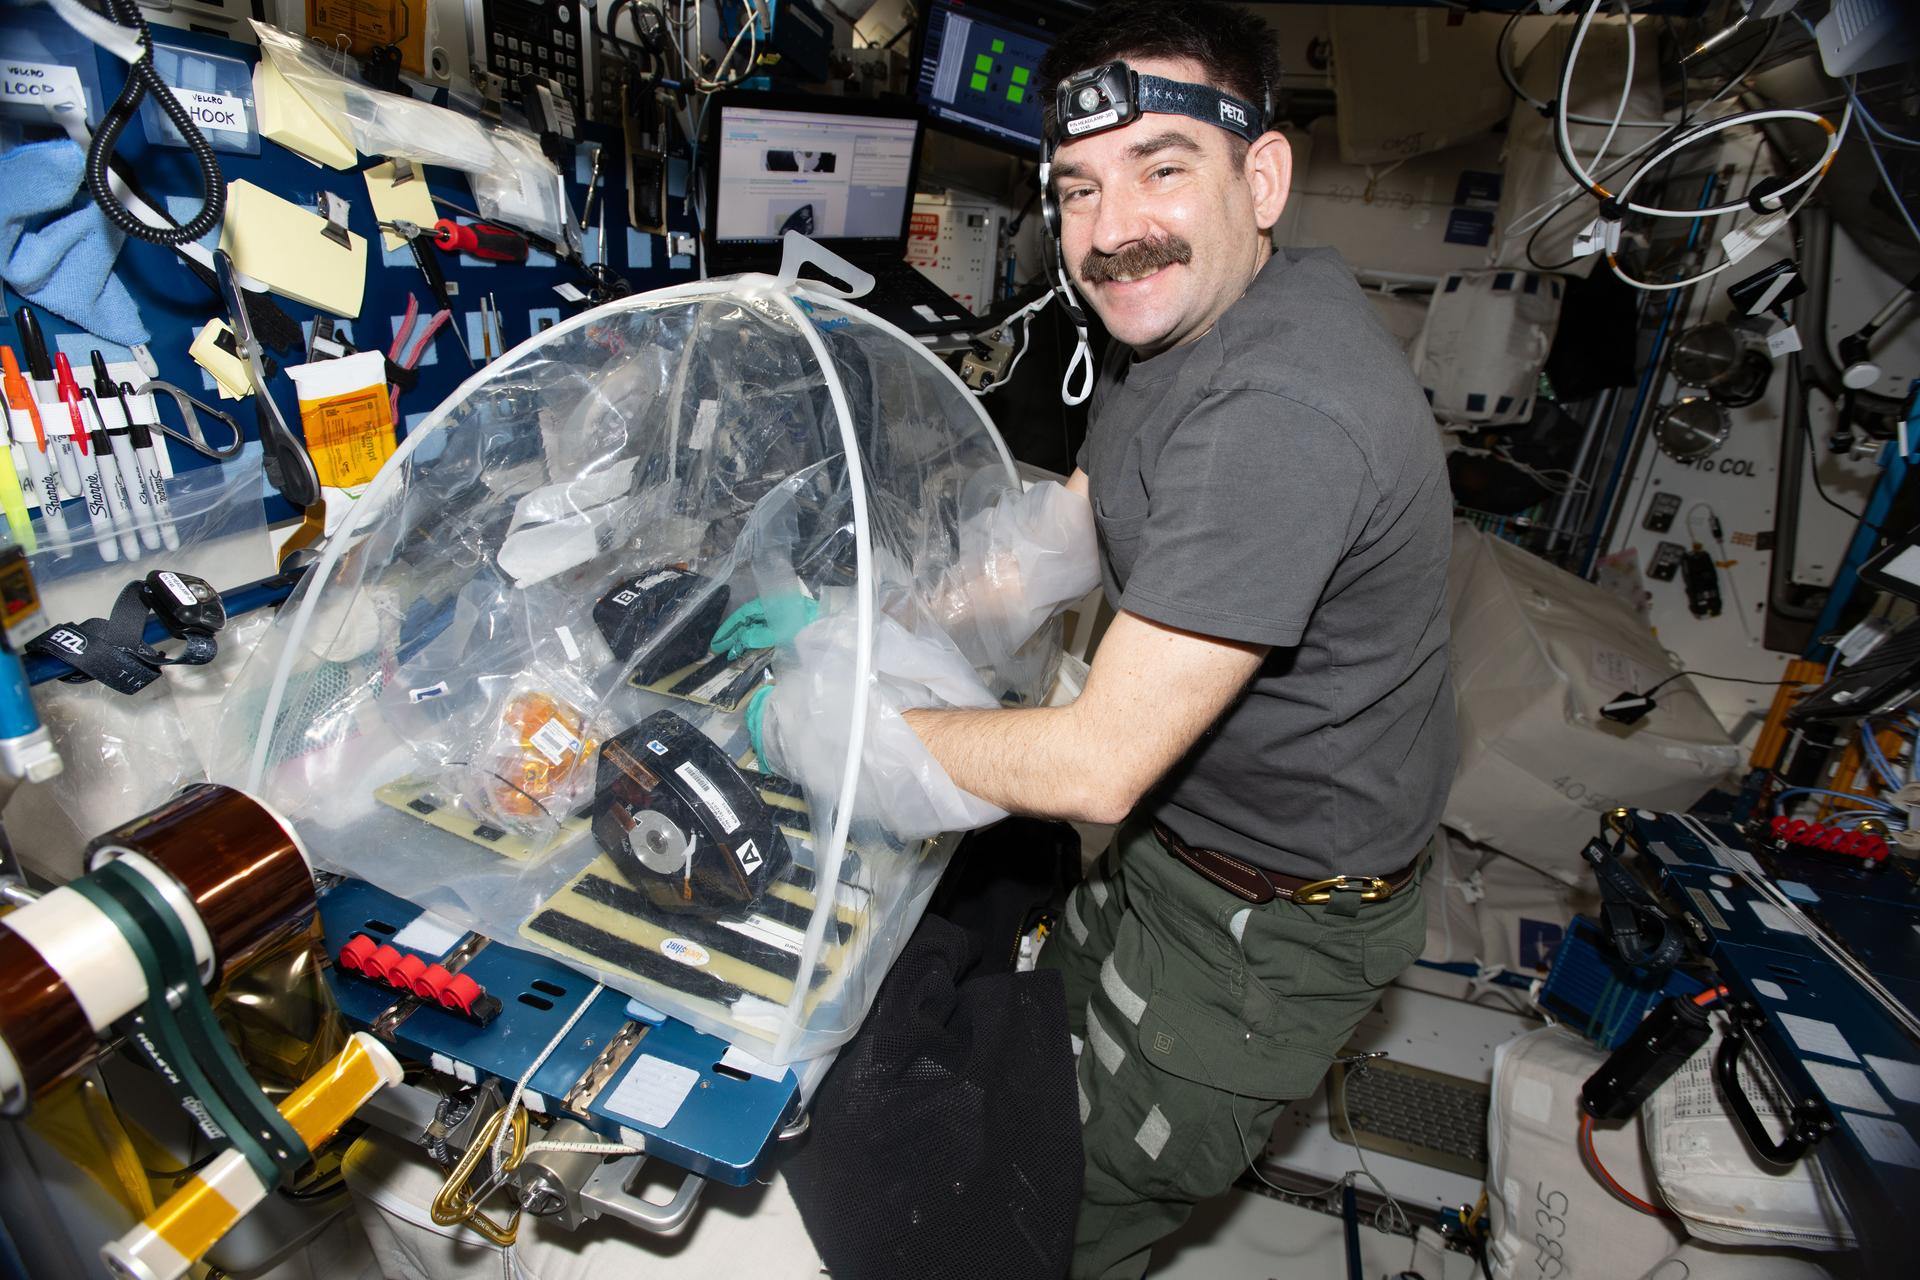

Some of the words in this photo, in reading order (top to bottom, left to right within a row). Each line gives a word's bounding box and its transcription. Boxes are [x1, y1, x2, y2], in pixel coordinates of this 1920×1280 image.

[8, 66, 44, 78] VELCRO
[192, 94, 223, 105] VELCRO
[1144, 87, 1185, 102] IKKA
[190, 106, 235, 125] HOOK
[1219, 100, 1249, 123] PETZL
[1720, 458, 1757, 477] COL
[42, 475, 61, 517] Sharpie
[84, 472, 108, 518] Sharpie
[618, 590, 634, 604] B
[50, 629, 84, 655] ETZL
[119, 669, 145, 688] TIK
[741, 842, 760, 865] A
[137, 1033, 180, 1084] KAPTON
